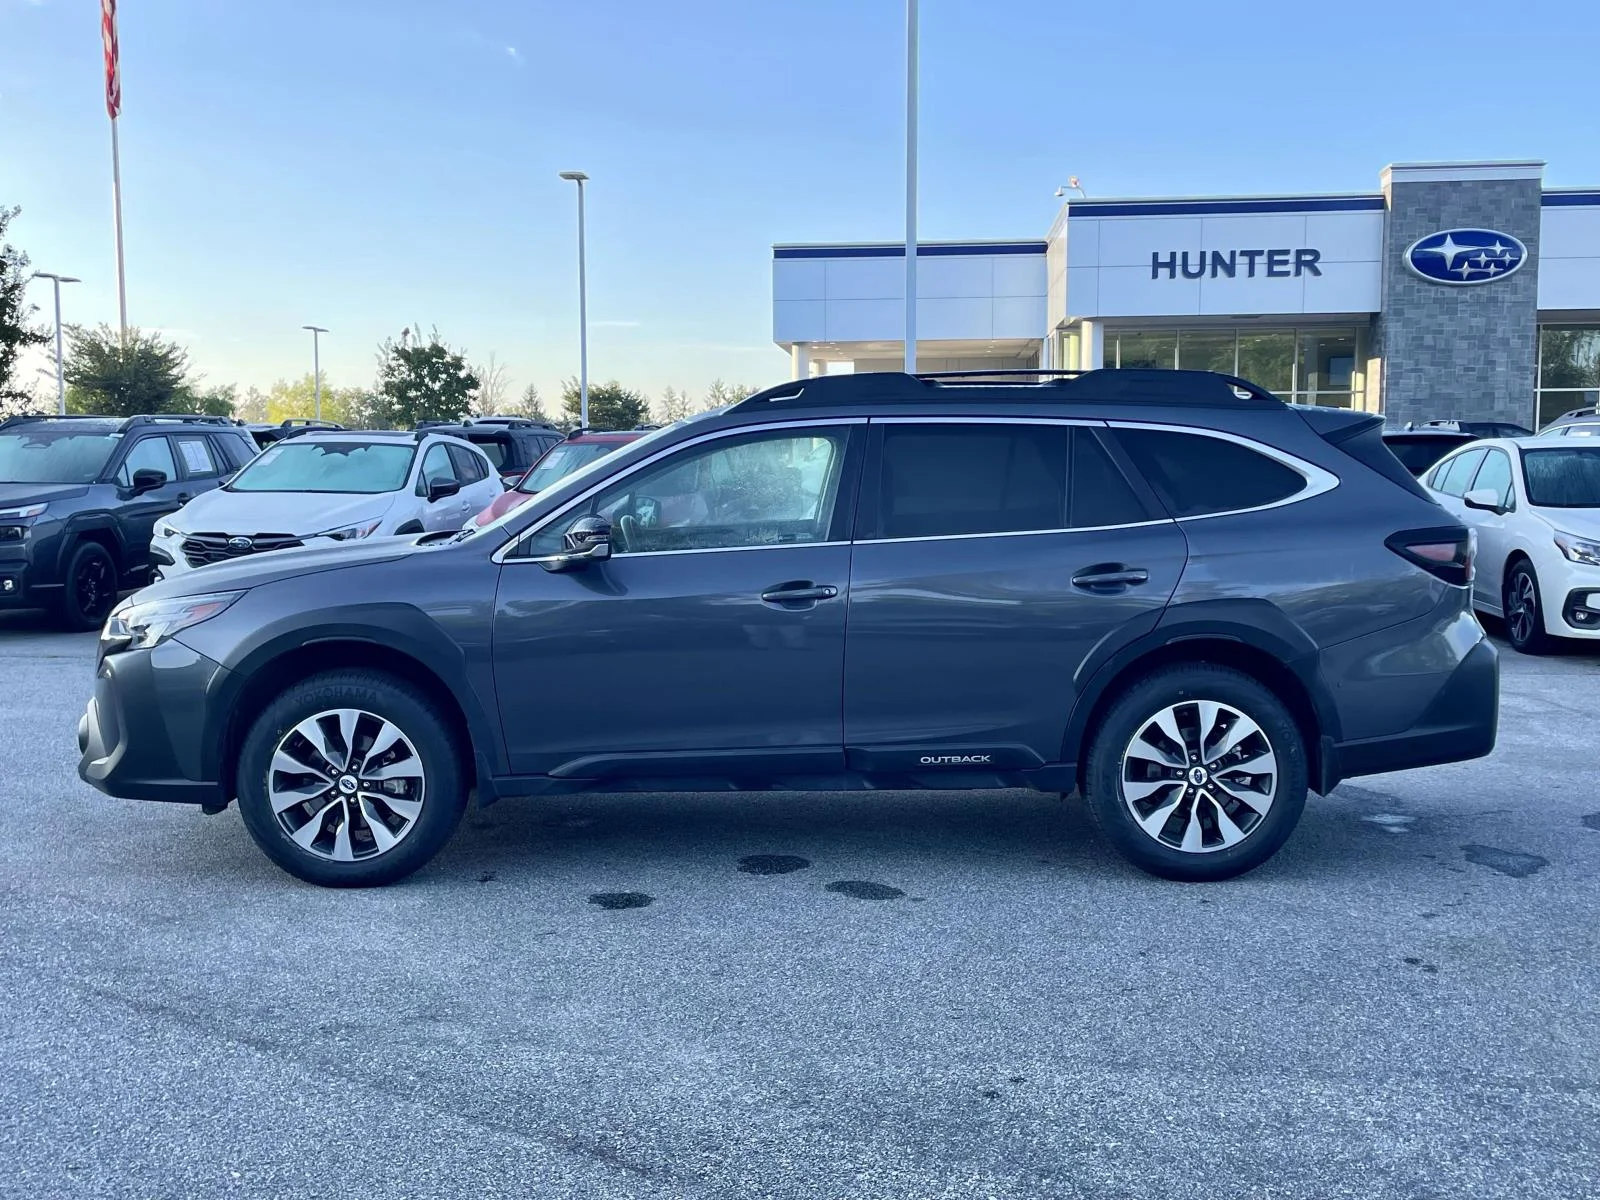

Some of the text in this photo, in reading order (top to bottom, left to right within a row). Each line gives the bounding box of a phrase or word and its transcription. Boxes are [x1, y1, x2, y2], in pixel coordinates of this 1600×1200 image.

[1151, 248, 1322, 278] HUNTER
[294, 686, 377, 704] YOKOHAMA
[919, 755, 991, 764] OUTBACK
